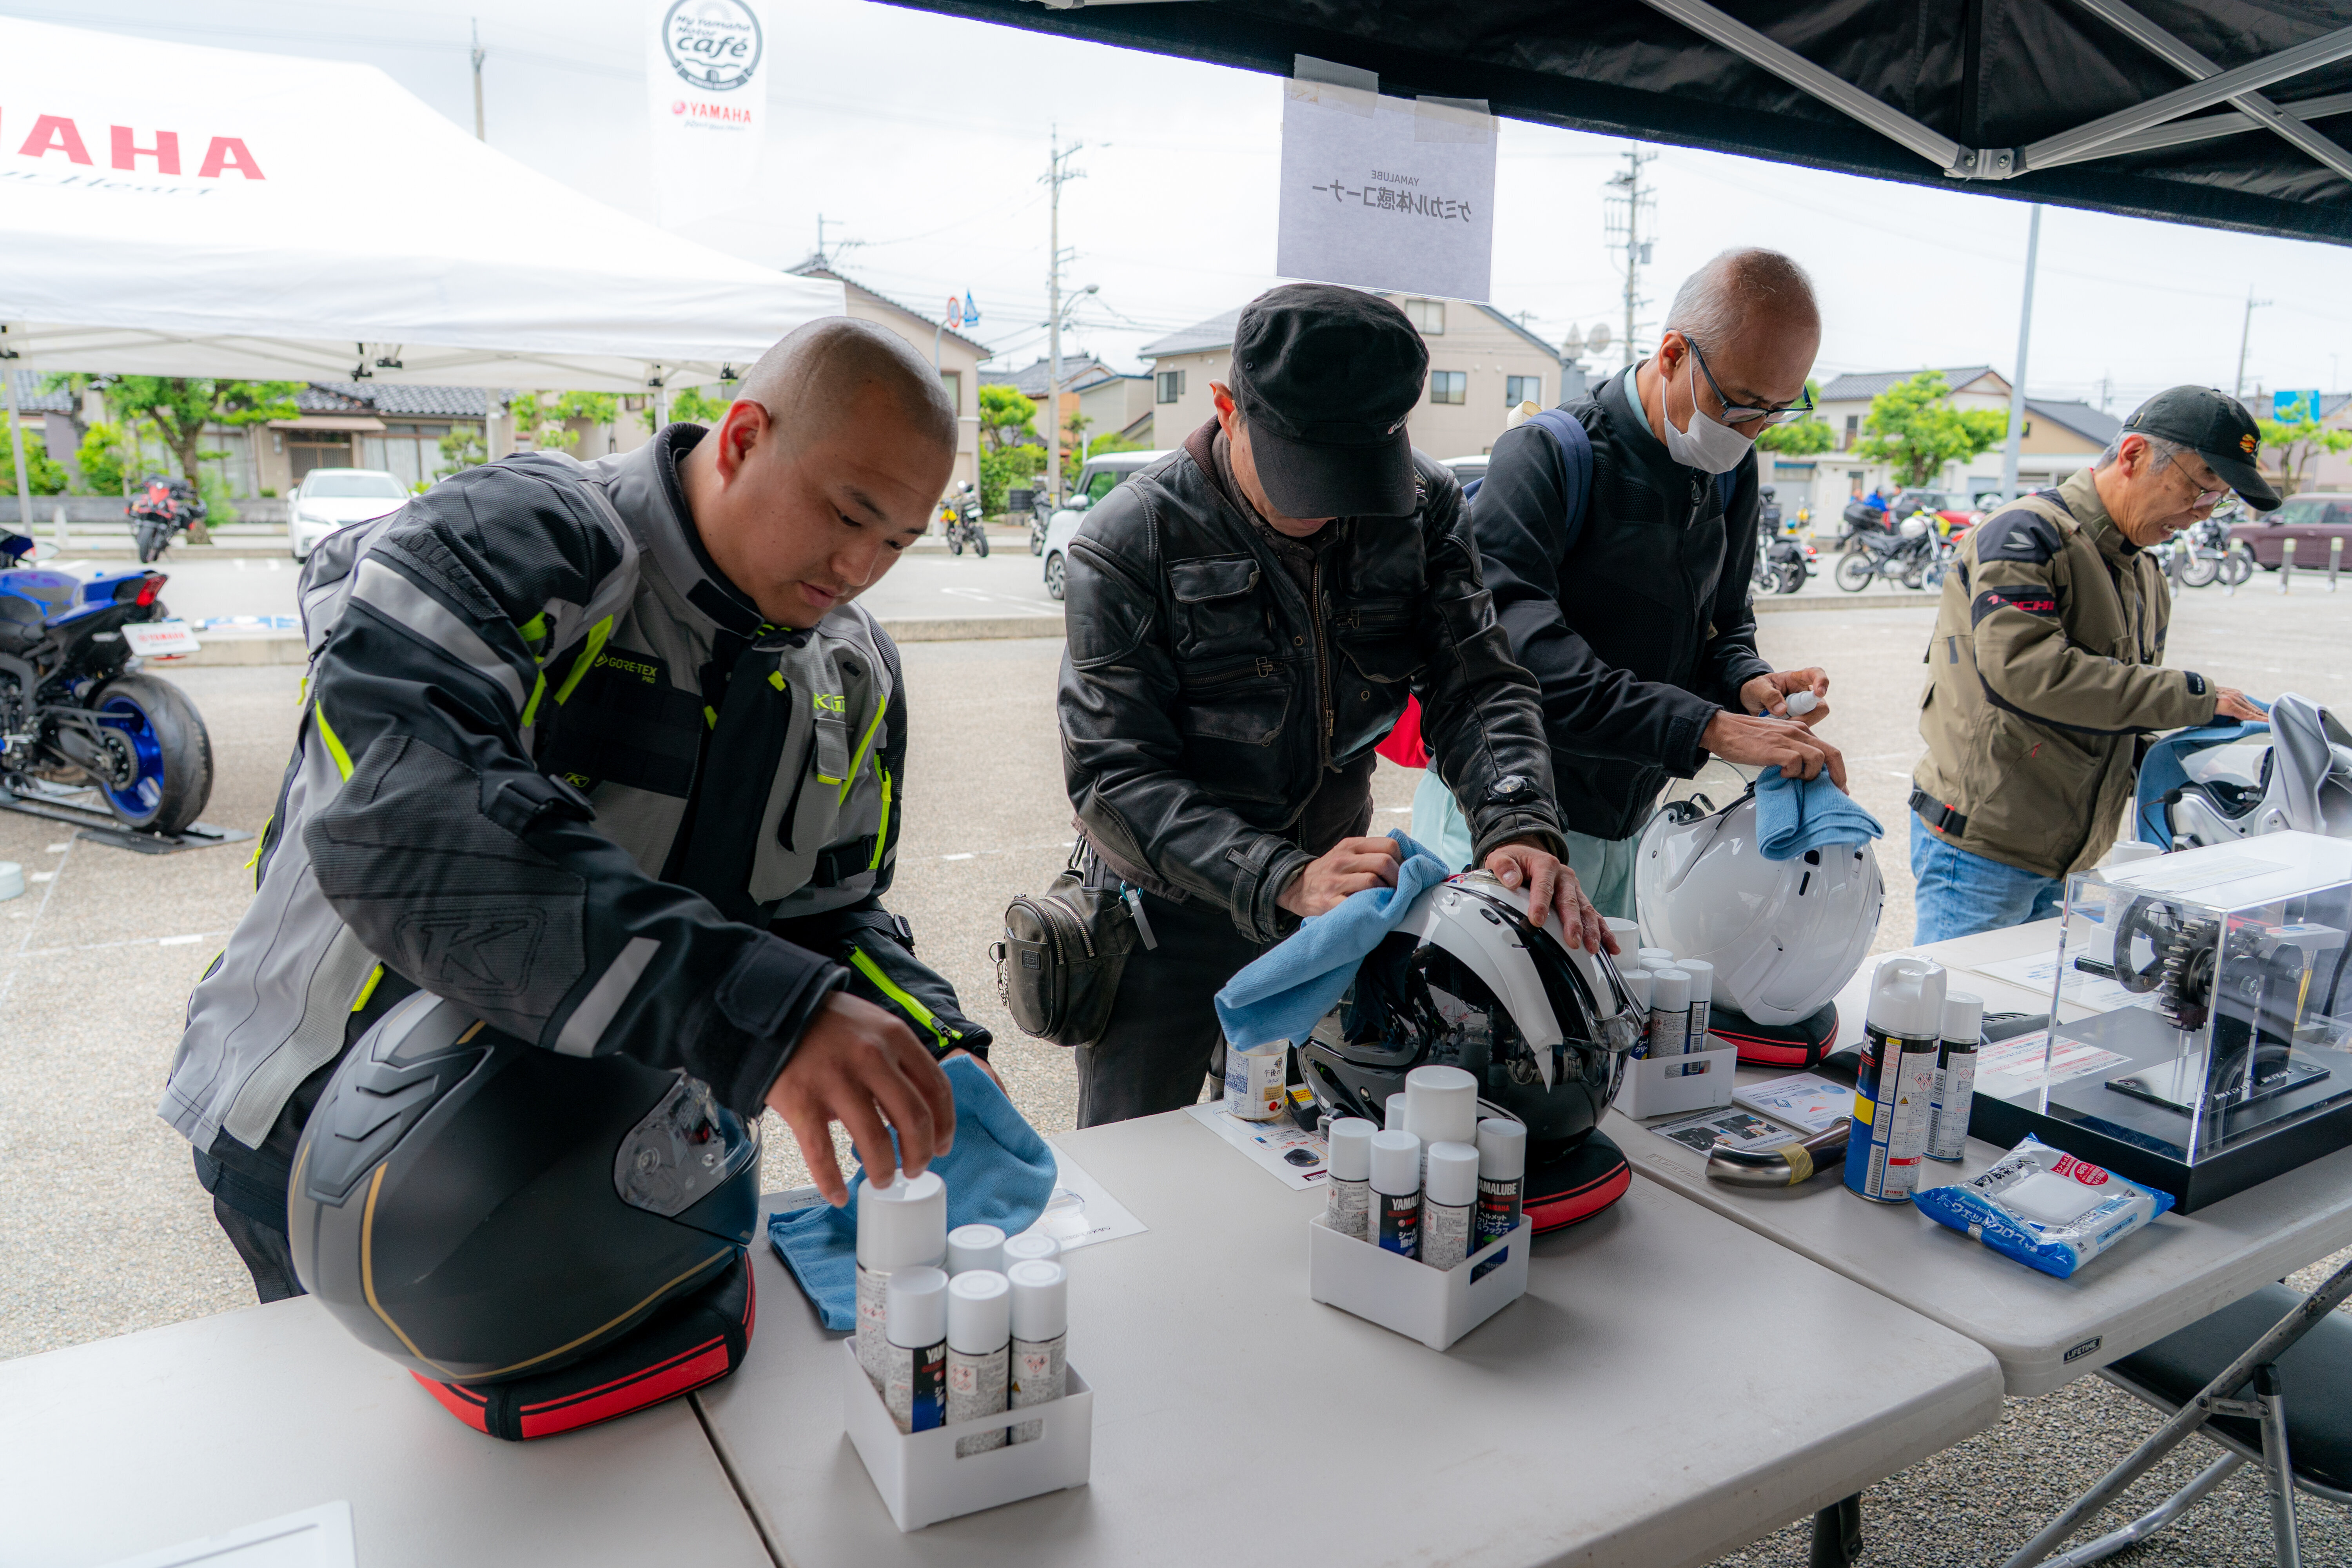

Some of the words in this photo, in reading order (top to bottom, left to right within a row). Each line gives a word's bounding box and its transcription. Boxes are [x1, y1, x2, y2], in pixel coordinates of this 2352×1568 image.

[677, 37, 748, 58] café
[690, 102, 751, 123] YAMAHA
[608, 657, 658, 677] GORE-TEX
[642, 675, 655, 684] PRO
[1477, 1217, 1510, 1228] クリーナー
[1480, 1212, 1507, 1221] ヘルメット
[2066, 1340, 2097, 1360] LIFETIME
